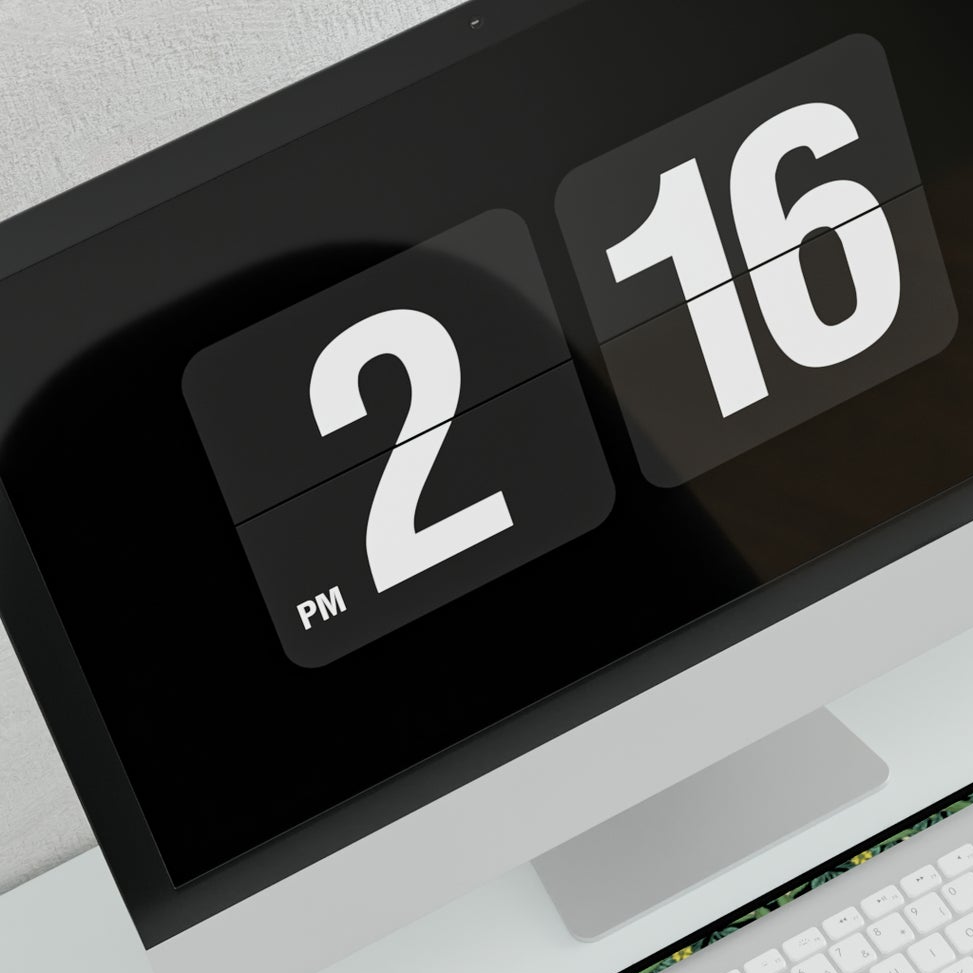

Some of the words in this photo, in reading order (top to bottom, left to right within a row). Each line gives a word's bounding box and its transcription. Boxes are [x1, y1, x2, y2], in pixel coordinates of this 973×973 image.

[605, 101, 902, 418] 16
[309, 308, 514, 594] 2
[297, 586, 346, 630] PM
[873, 928, 881, 936] 8
